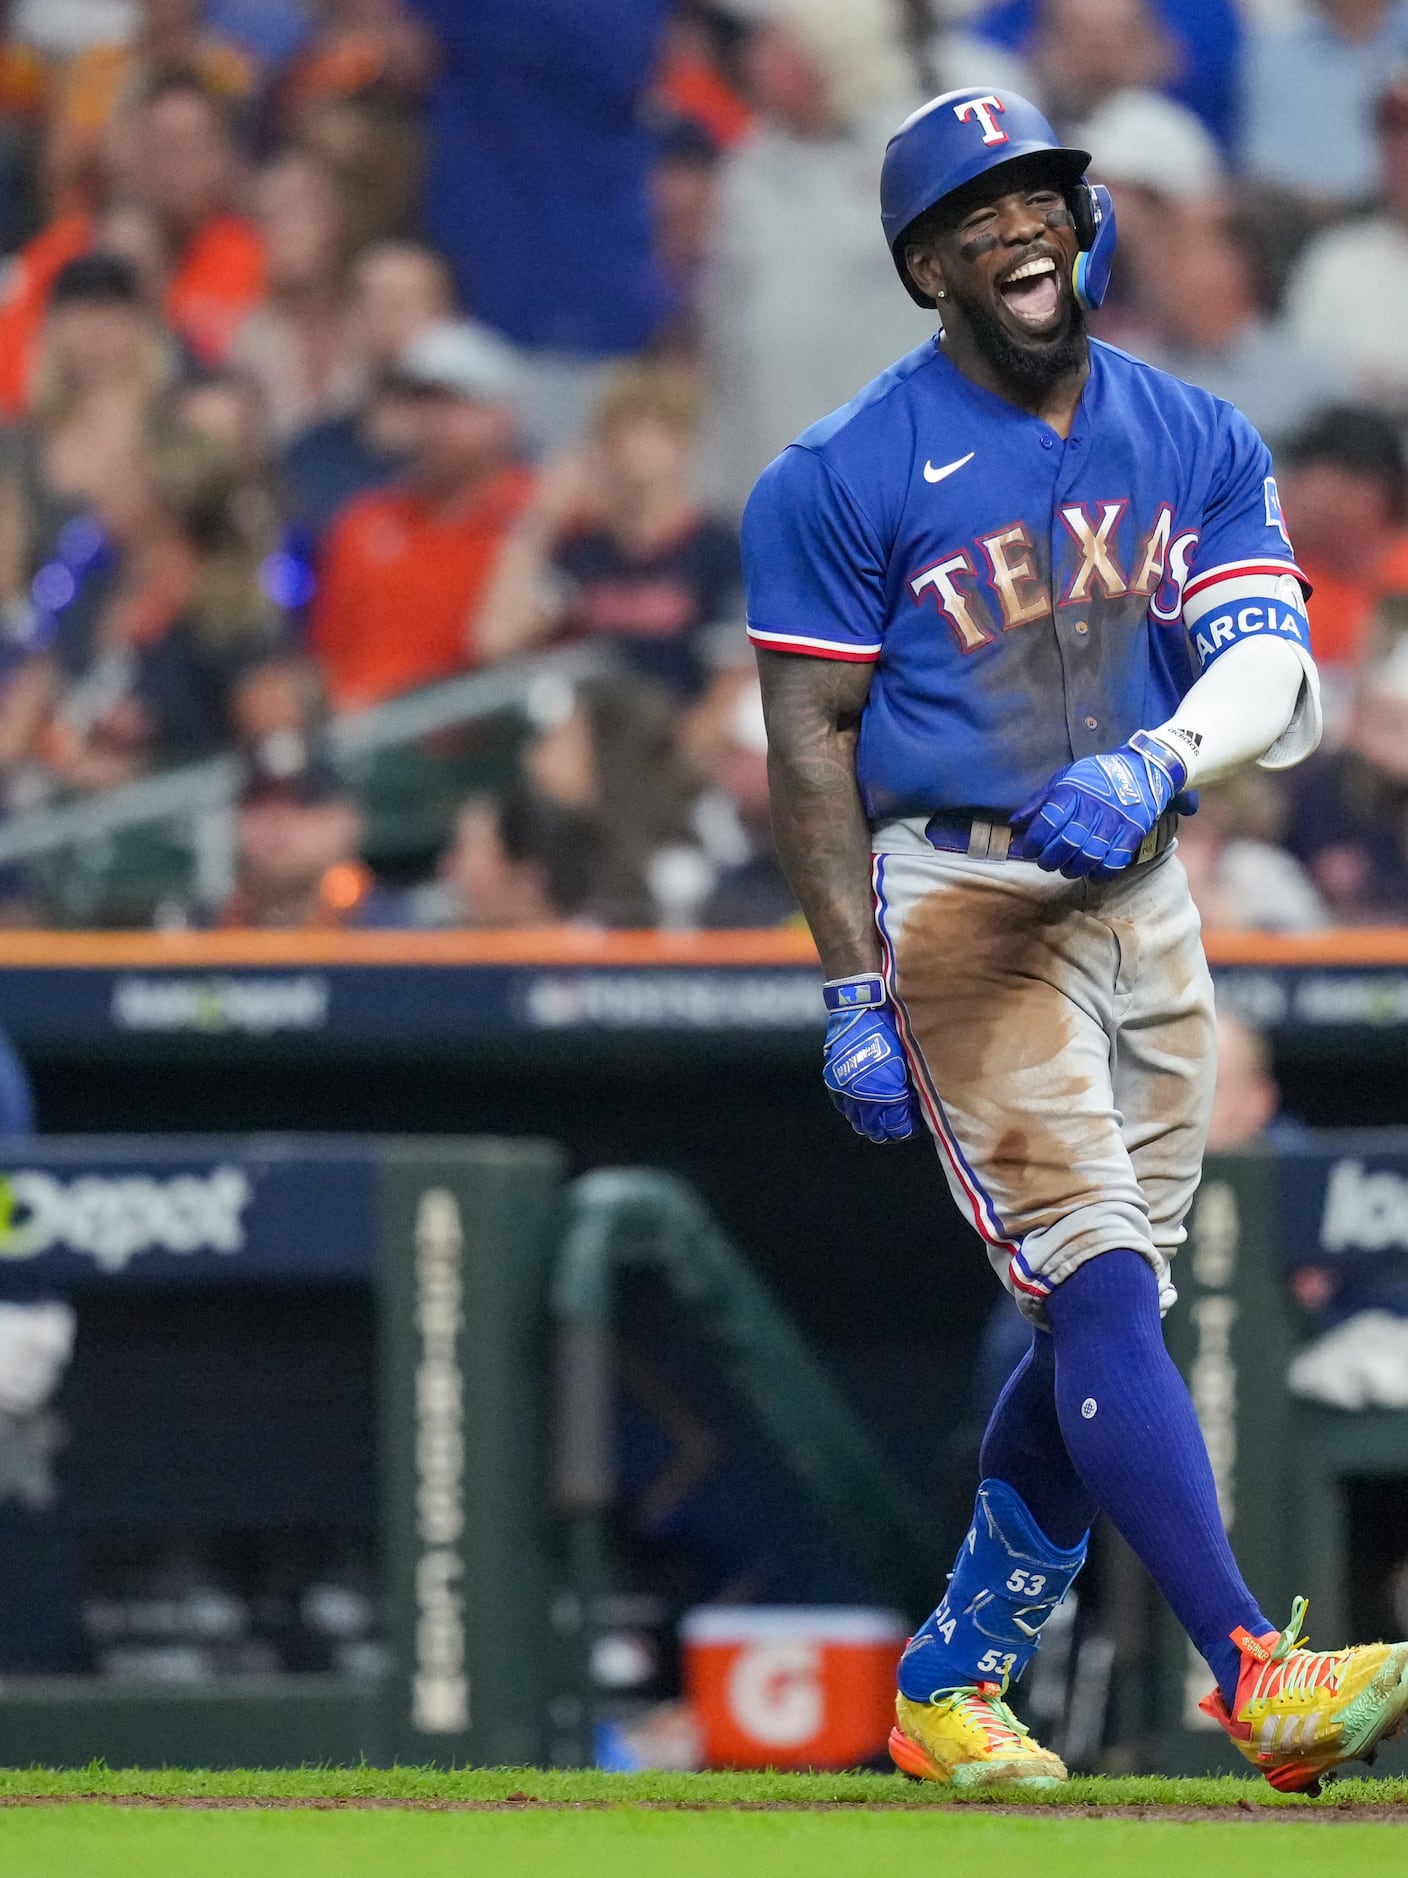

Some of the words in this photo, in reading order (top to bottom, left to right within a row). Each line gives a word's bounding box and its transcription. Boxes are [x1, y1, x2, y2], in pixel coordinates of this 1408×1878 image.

[952, 95, 1009, 147] T
[906, 498, 1200, 655] TEXAS
[1167, 727, 1201, 757] adidas
[836, 1036, 884, 1078] Franklin
[1006, 1568, 1047, 1597] 53
[976, 1649, 1017, 1675] 53
[727, 1636, 826, 1748] G
